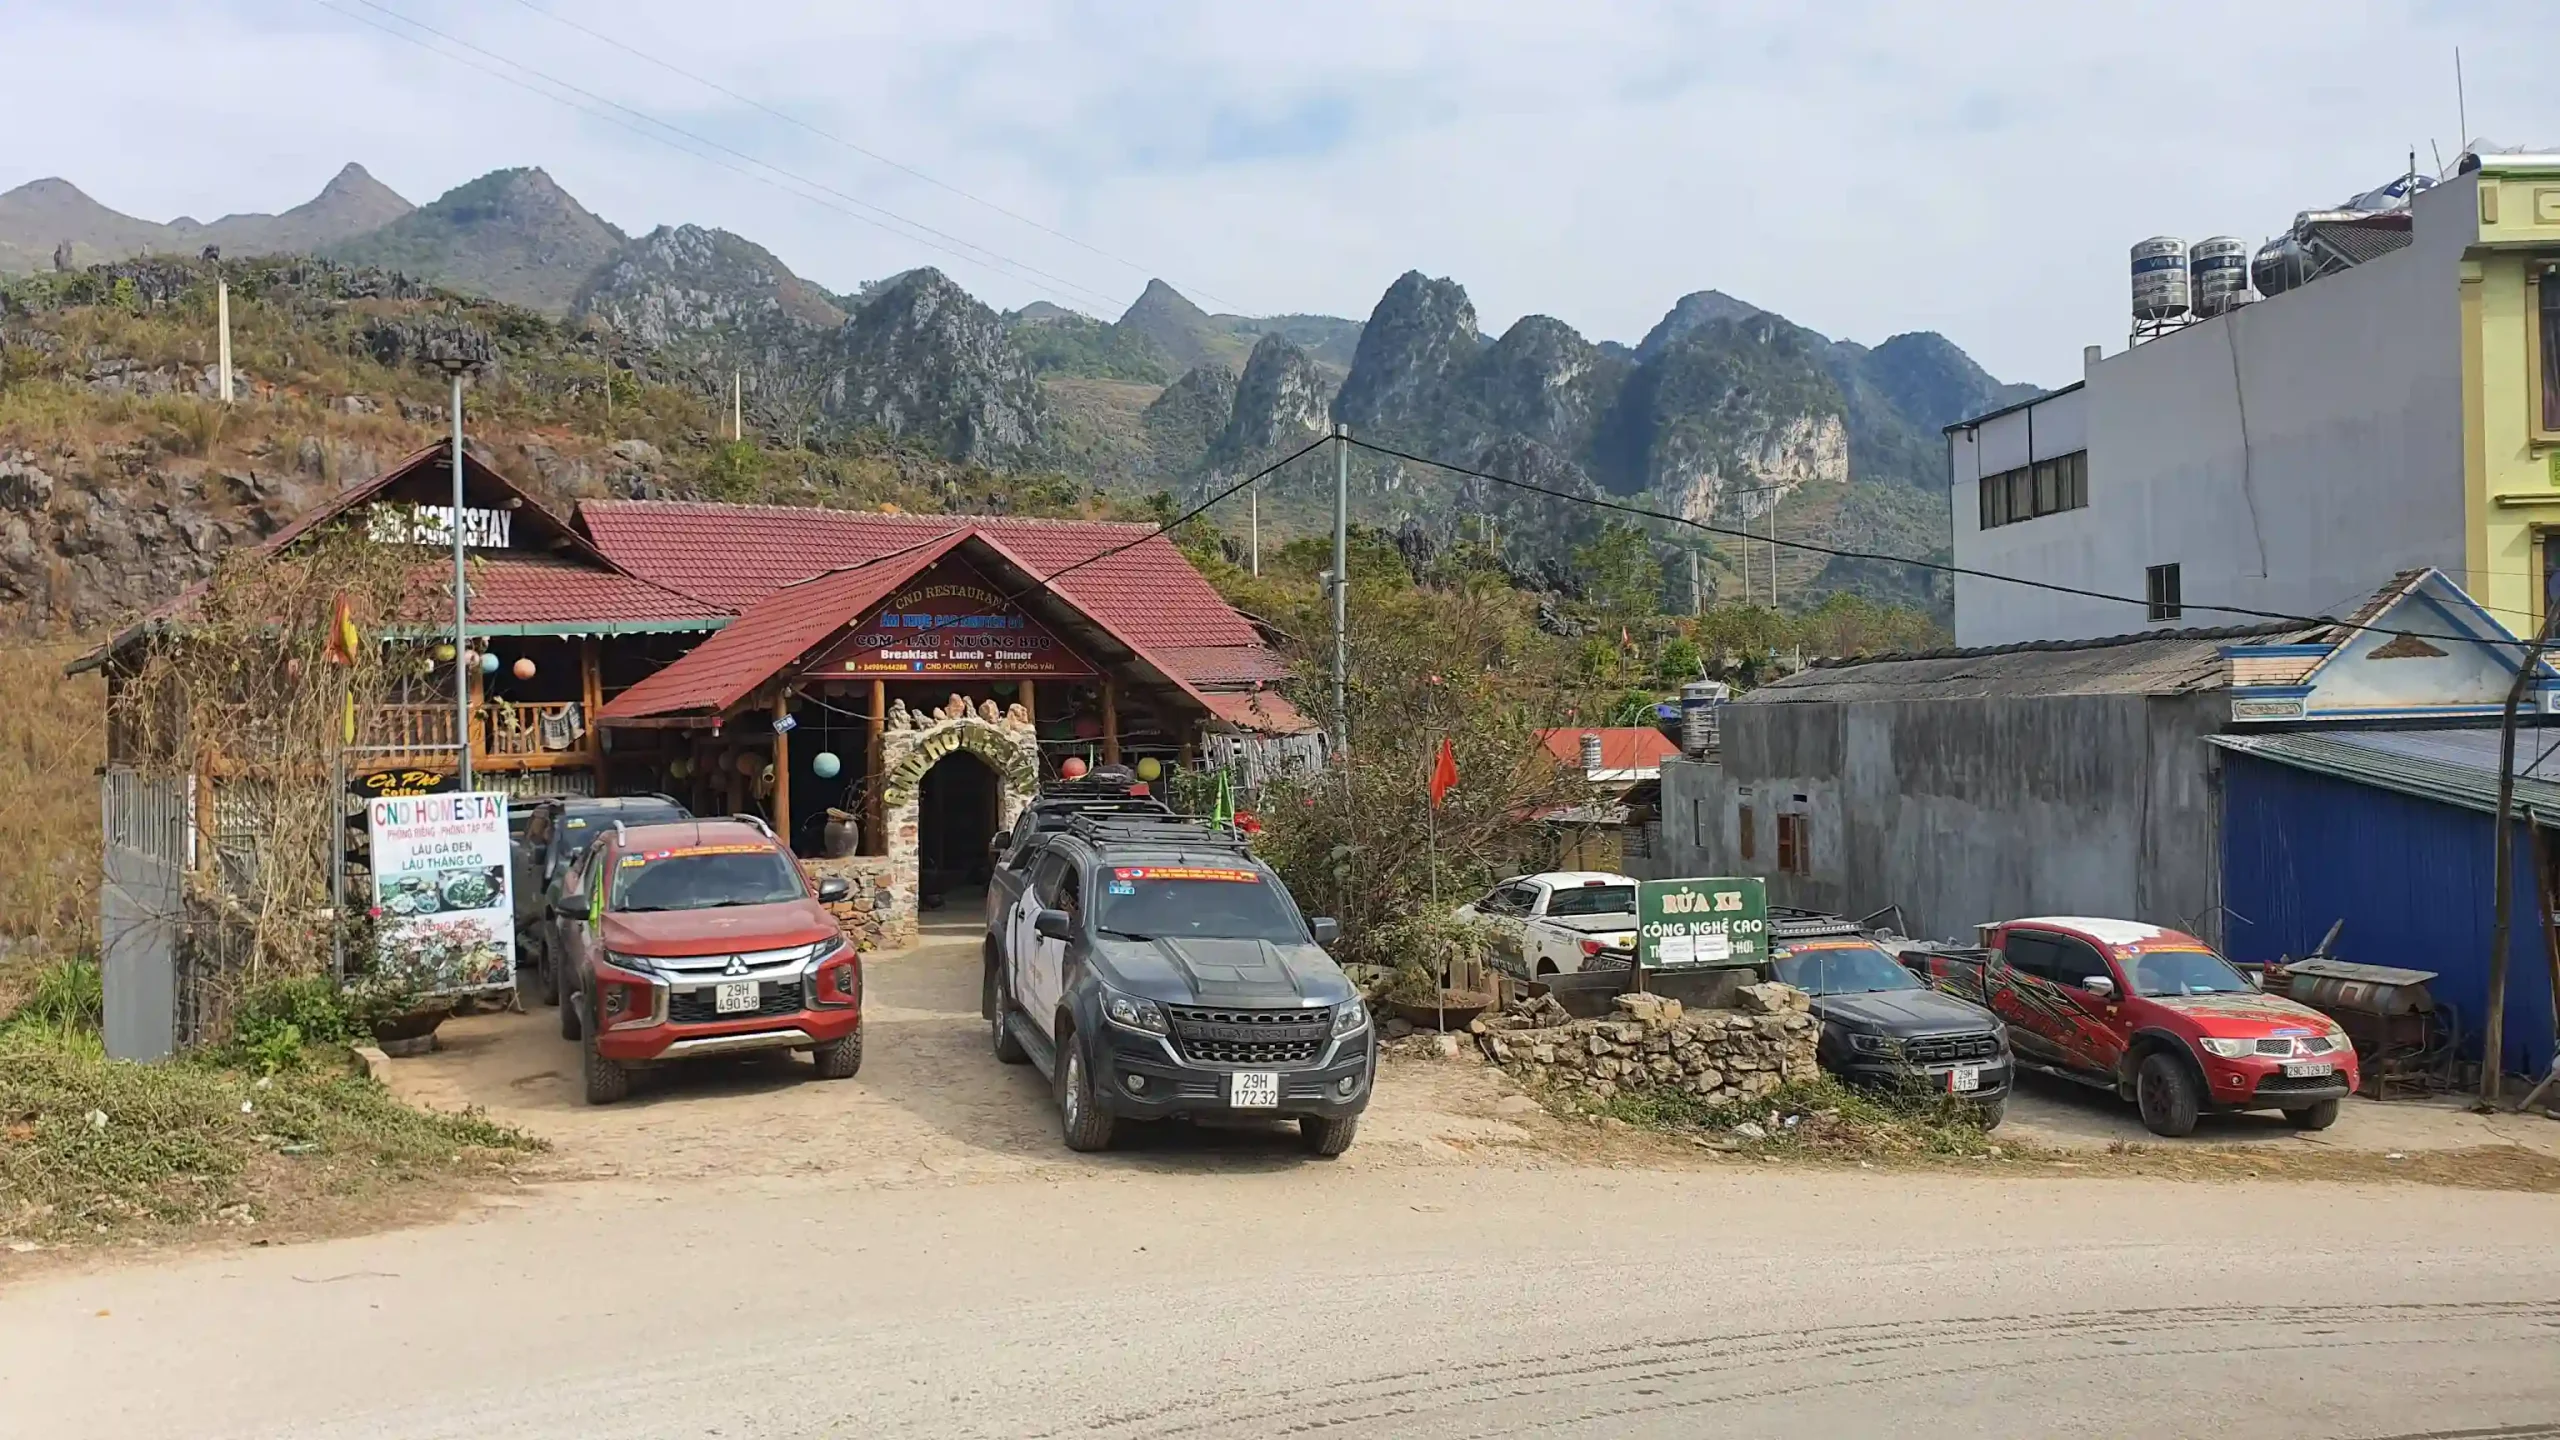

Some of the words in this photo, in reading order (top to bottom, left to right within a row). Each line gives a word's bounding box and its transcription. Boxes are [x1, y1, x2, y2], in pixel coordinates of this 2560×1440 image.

[895, 590, 922, 610] CND
[925, 584, 1010, 612] RESTAURANT
[1019, 636, 1050, 650] BBQ
[881, 650, 938, 659] Breakfast
[949, 650, 984, 659] Lunch
[995, 650, 1032, 659] Dinner
[884, 753, 927, 807] CND
[922, 724, 1039, 795] HOTAY
[366, 773, 397, 788] Cà
[402, 770, 443, 787] Phê
[381, 787, 427, 797] Coffee
[376, 802, 410, 826] CND
[415, 795, 504, 824] HOMESTAY
[452, 841, 473, 853] ĐEN
[1662, 886, 1710, 914] RỬA
[1714, 891, 1742, 911] XE
[1642, 921, 1686, 938] CÔNG
[1733, 919, 1762, 933] CAO
[727, 983, 749, 997] 29H
[1243, 1074, 1267, 1088] 29H
[1958, 1068, 1973, 1080] 29H
[1235, 1090, 1276, 1104] 172.32
